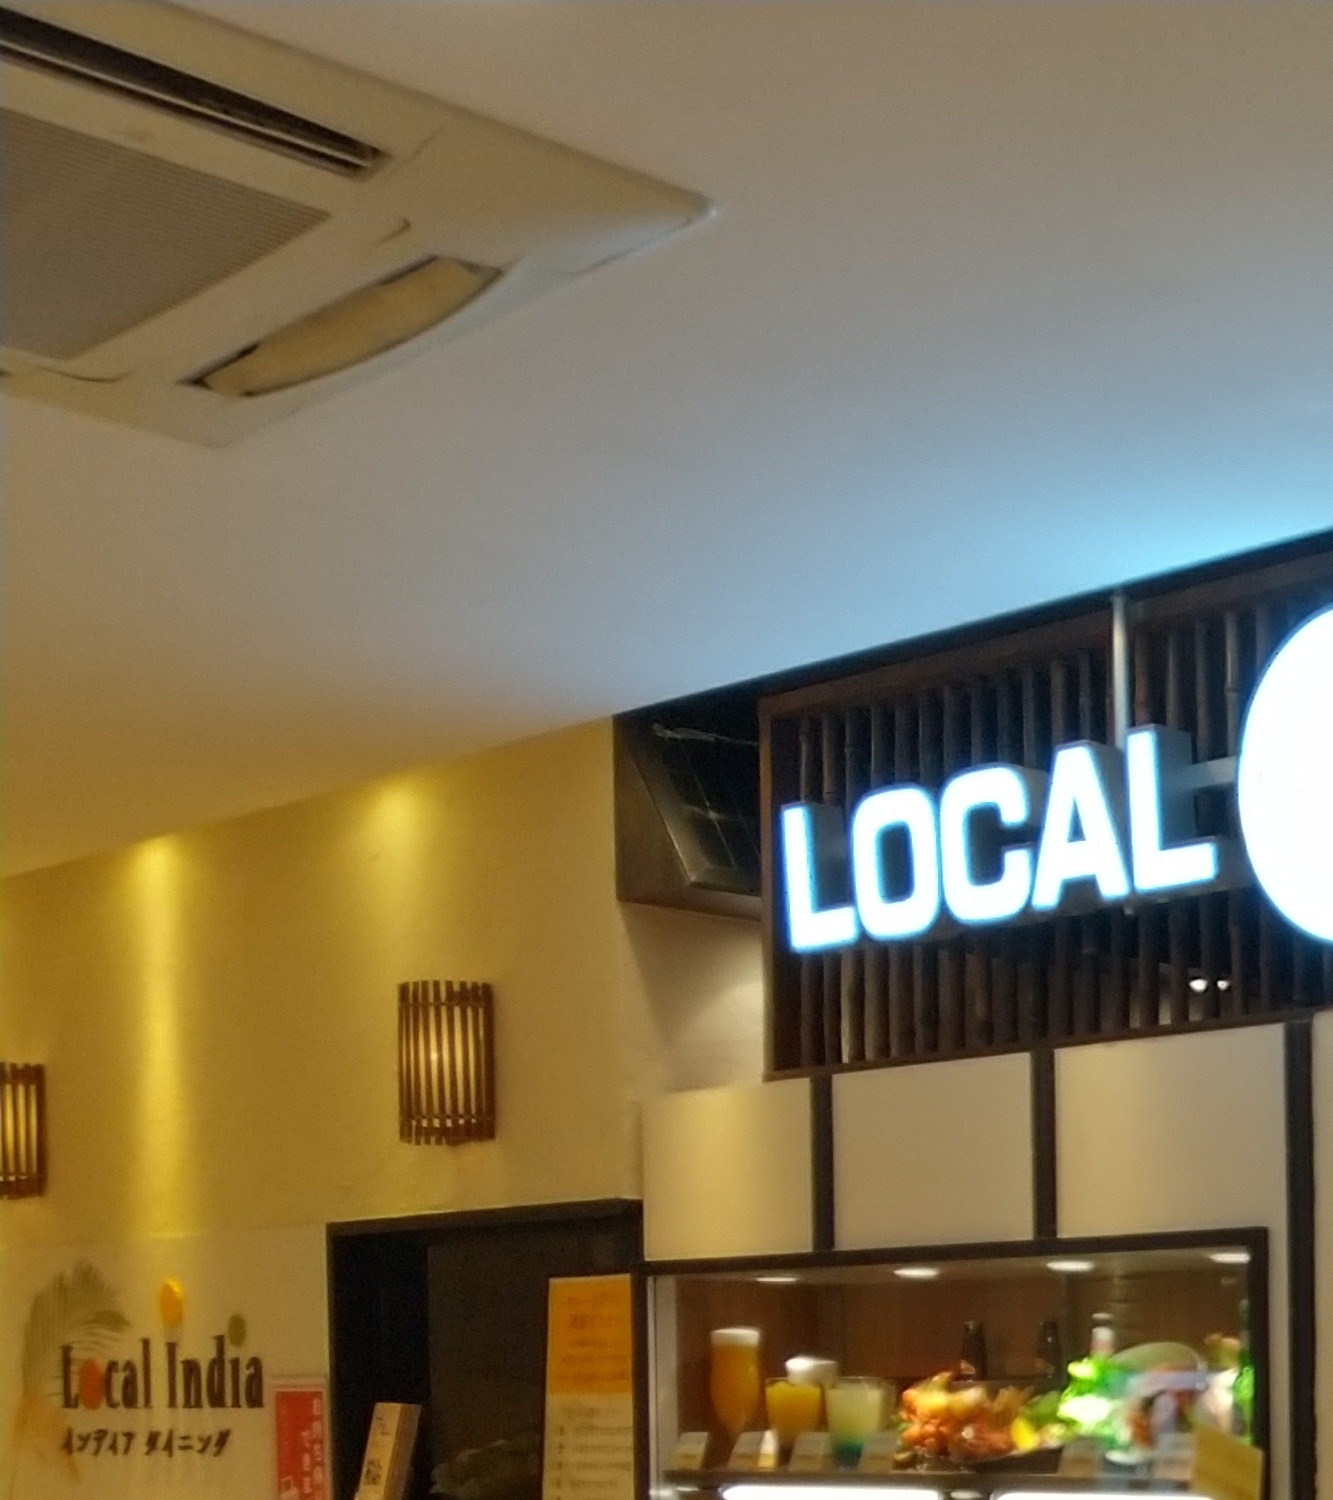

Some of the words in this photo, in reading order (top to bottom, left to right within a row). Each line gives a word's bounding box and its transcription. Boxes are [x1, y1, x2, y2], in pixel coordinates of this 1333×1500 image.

[781, 727, 1217, 952] LOCAL
[60, 1337, 153, 1410] Local
[165, 1314, 265, 1410] India
